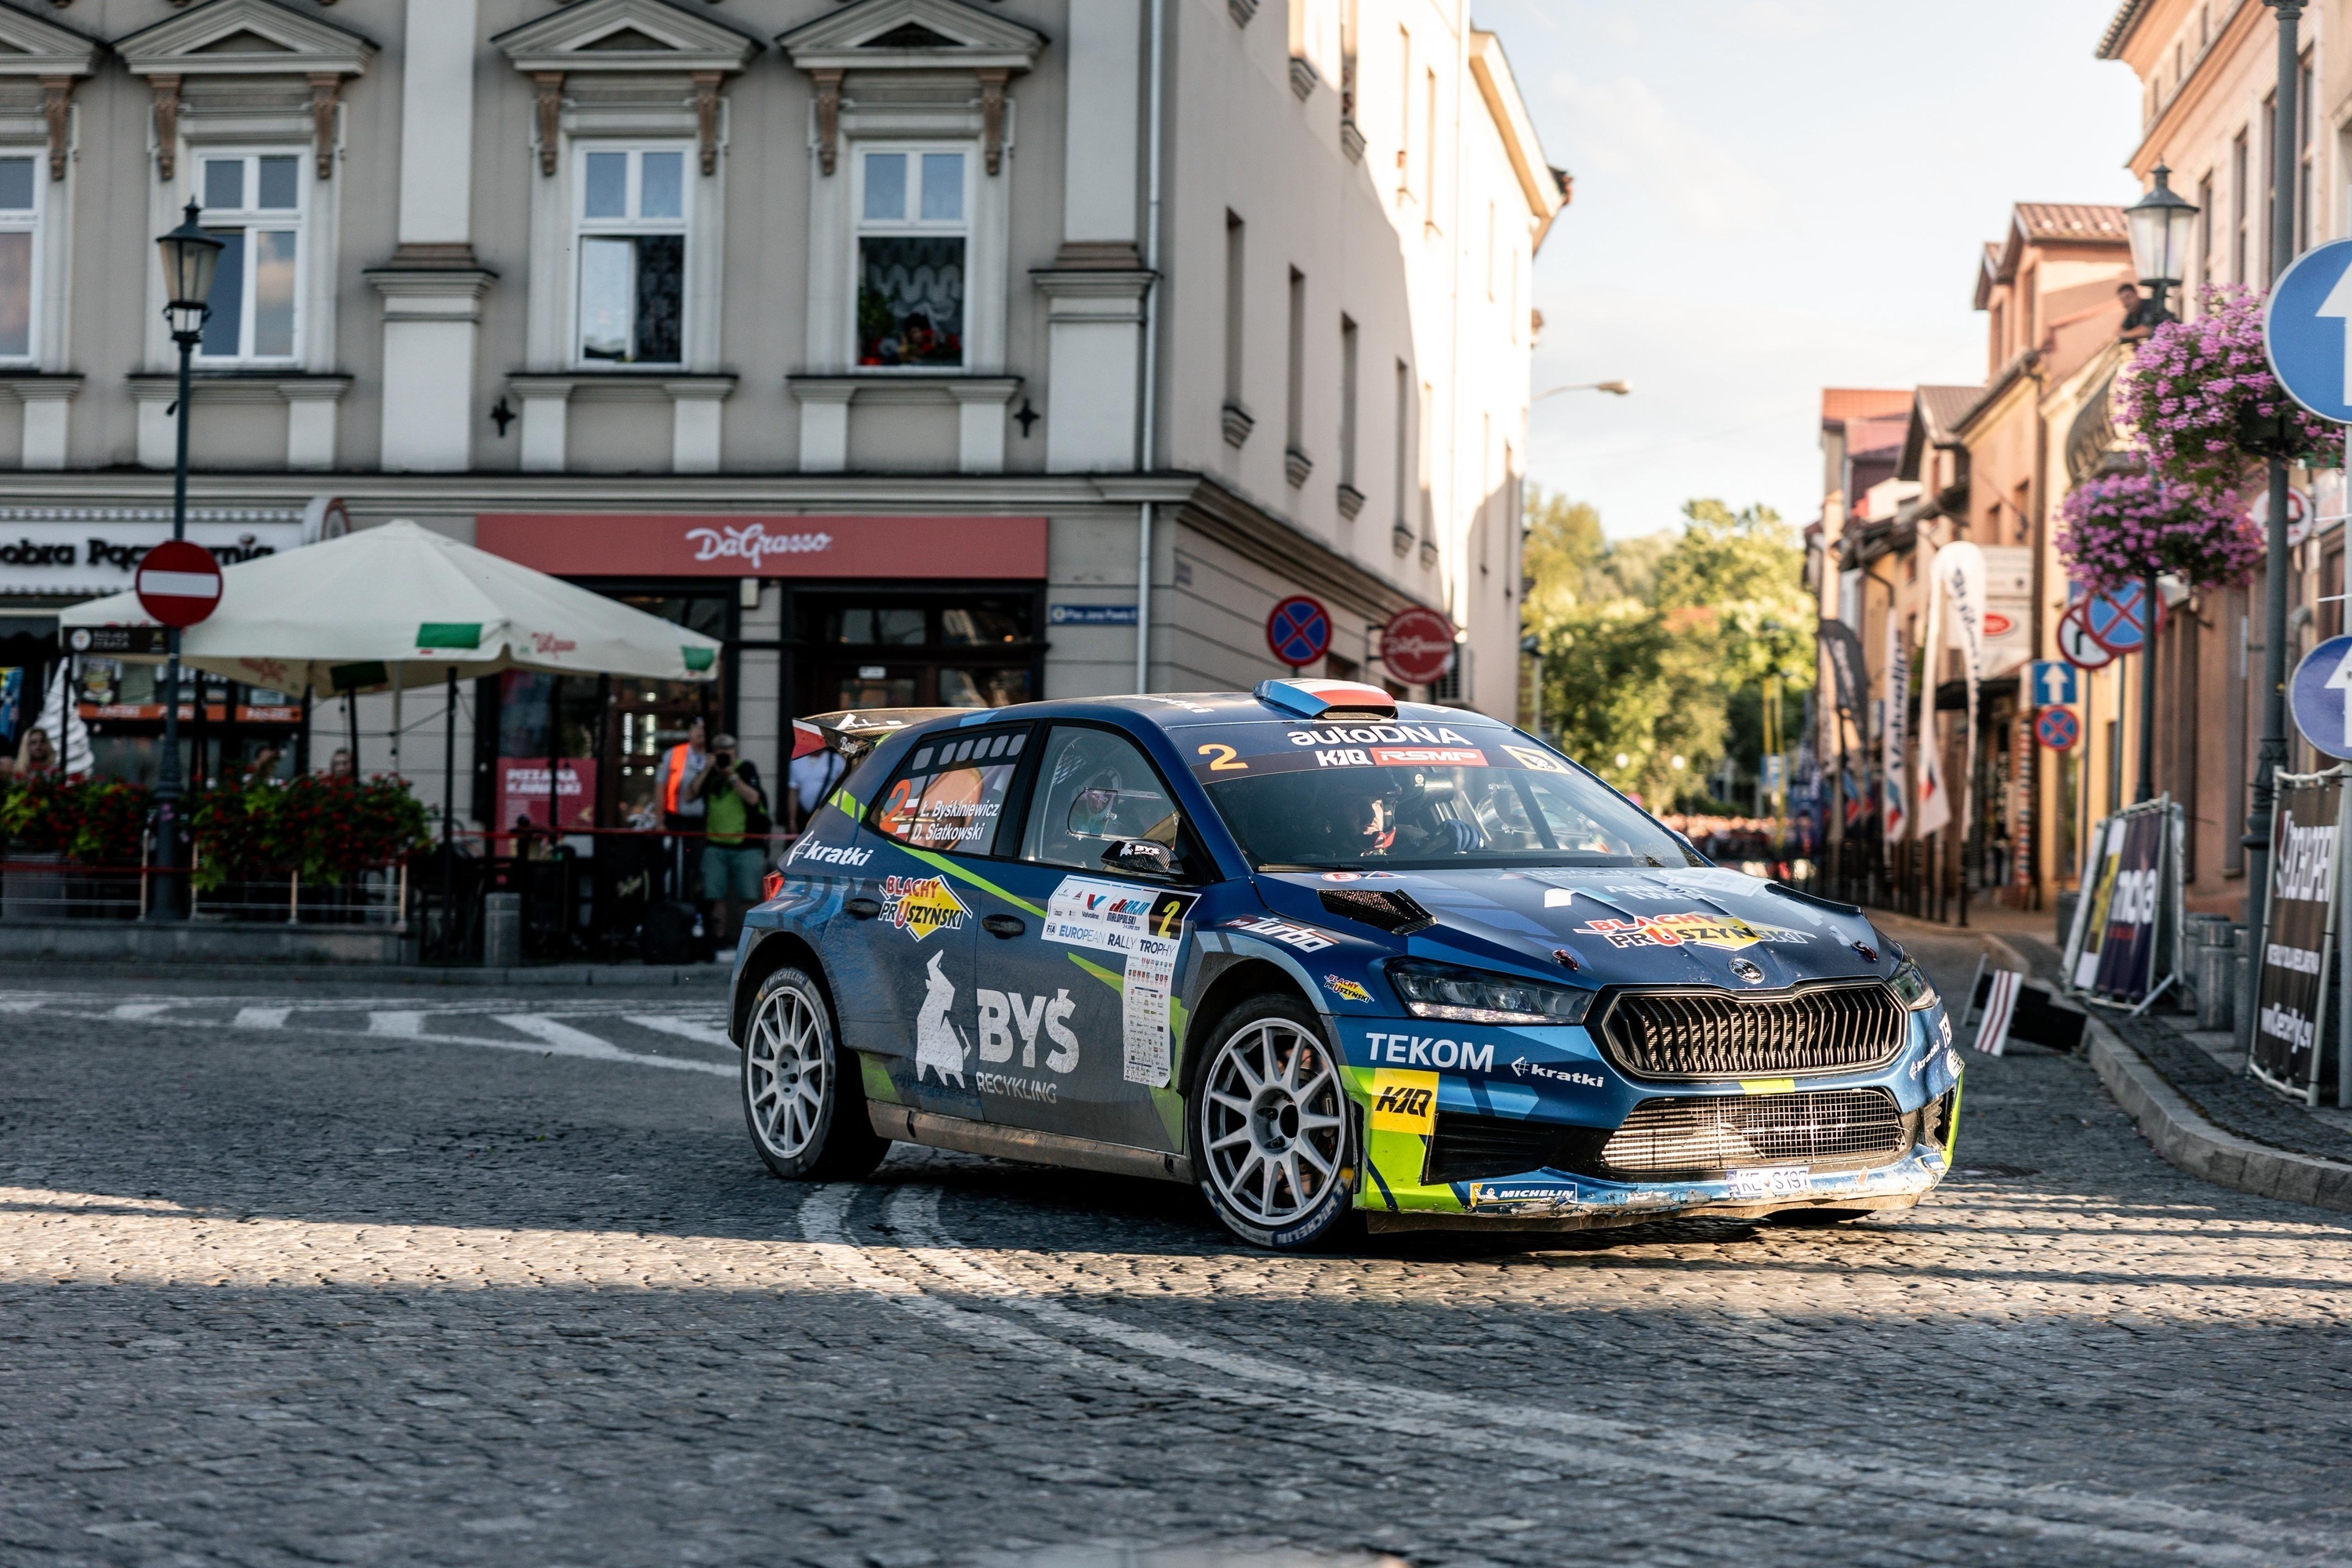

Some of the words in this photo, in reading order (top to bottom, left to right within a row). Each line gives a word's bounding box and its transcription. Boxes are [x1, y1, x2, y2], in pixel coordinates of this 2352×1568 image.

[0, 538, 75, 565] obra
[1287, 725, 1474, 746] autoDNA
[1197, 744, 1249, 771] 2
[1377, 750, 1477, 762] RSMP
[880, 779, 912, 833] 2
[932, 799, 1000, 820] Byśkiniewicz
[911, 823, 922, 840] D.
[925, 822, 985, 840] Siatkowski
[804, 840, 874, 866] kratki
[886, 877, 941, 898] BLACHY
[880, 900, 964, 928] PRUSZYŃSKI
[1081, 911, 1100, 920] Valvoline
[1106, 912, 1137, 925] MAŁOPOLSKI
[1157, 901, 1181, 939] 2
[1589, 913, 1715, 932] BLACHY
[1059, 924, 1106, 944] EUROPEAN
[1107, 933, 1137, 950] RALLY
[1140, 939, 1176, 956] TROPHY
[1238, 916, 1334, 953] turbo
[1609, 924, 1808, 947] PRUSZYŃSKI
[768, 971, 805, 987] MICHELIN
[1328, 975, 1359, 989] BLACHY
[1324, 982, 1370, 1003] PRUSZYŃSKI
[1366, 1032, 1495, 1073] TEKOM
[1531, 1064, 1604, 1088] kratki
[978, 1074, 1057, 1104] RECYKLING
[1499, 1189, 1574, 1200] MICHELIN
[1277, 1194, 1338, 1245] MICHELIN
